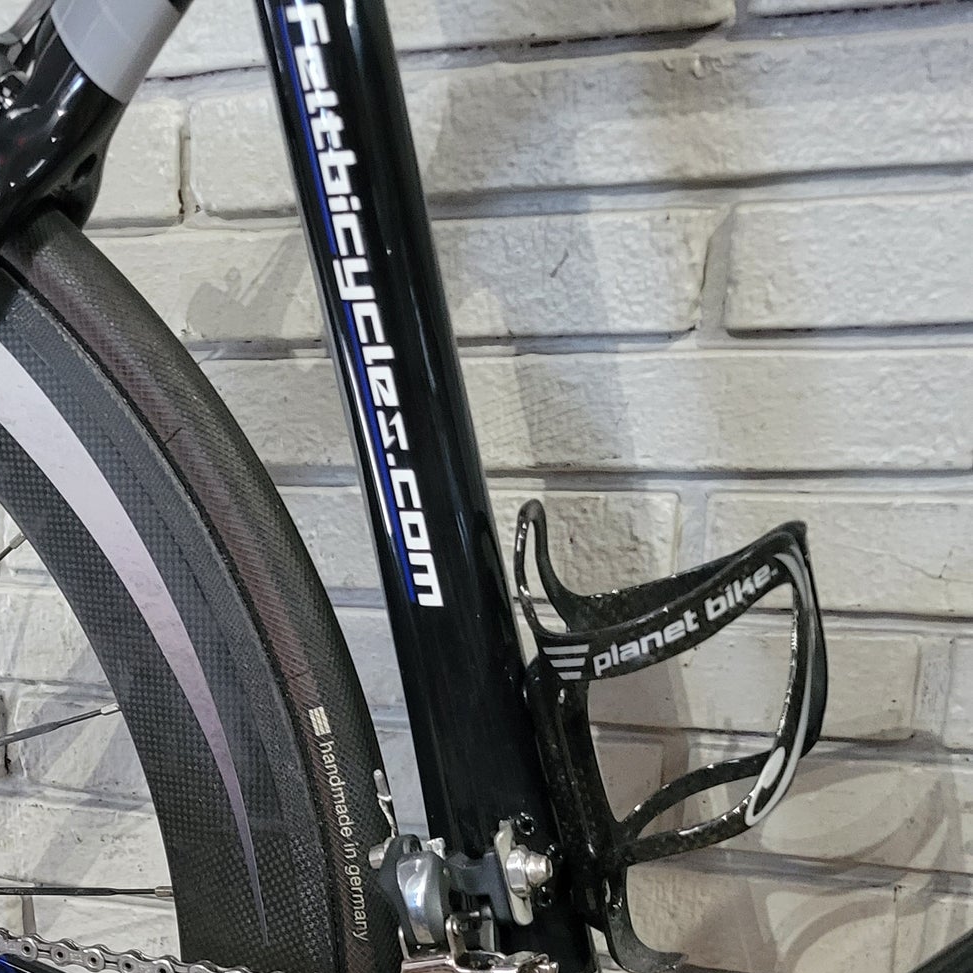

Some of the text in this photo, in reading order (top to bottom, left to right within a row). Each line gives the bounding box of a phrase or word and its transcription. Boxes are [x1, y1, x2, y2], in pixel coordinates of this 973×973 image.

[593, 609, 700, 677] planet
[319, 740, 369, 942] handmade in germany
